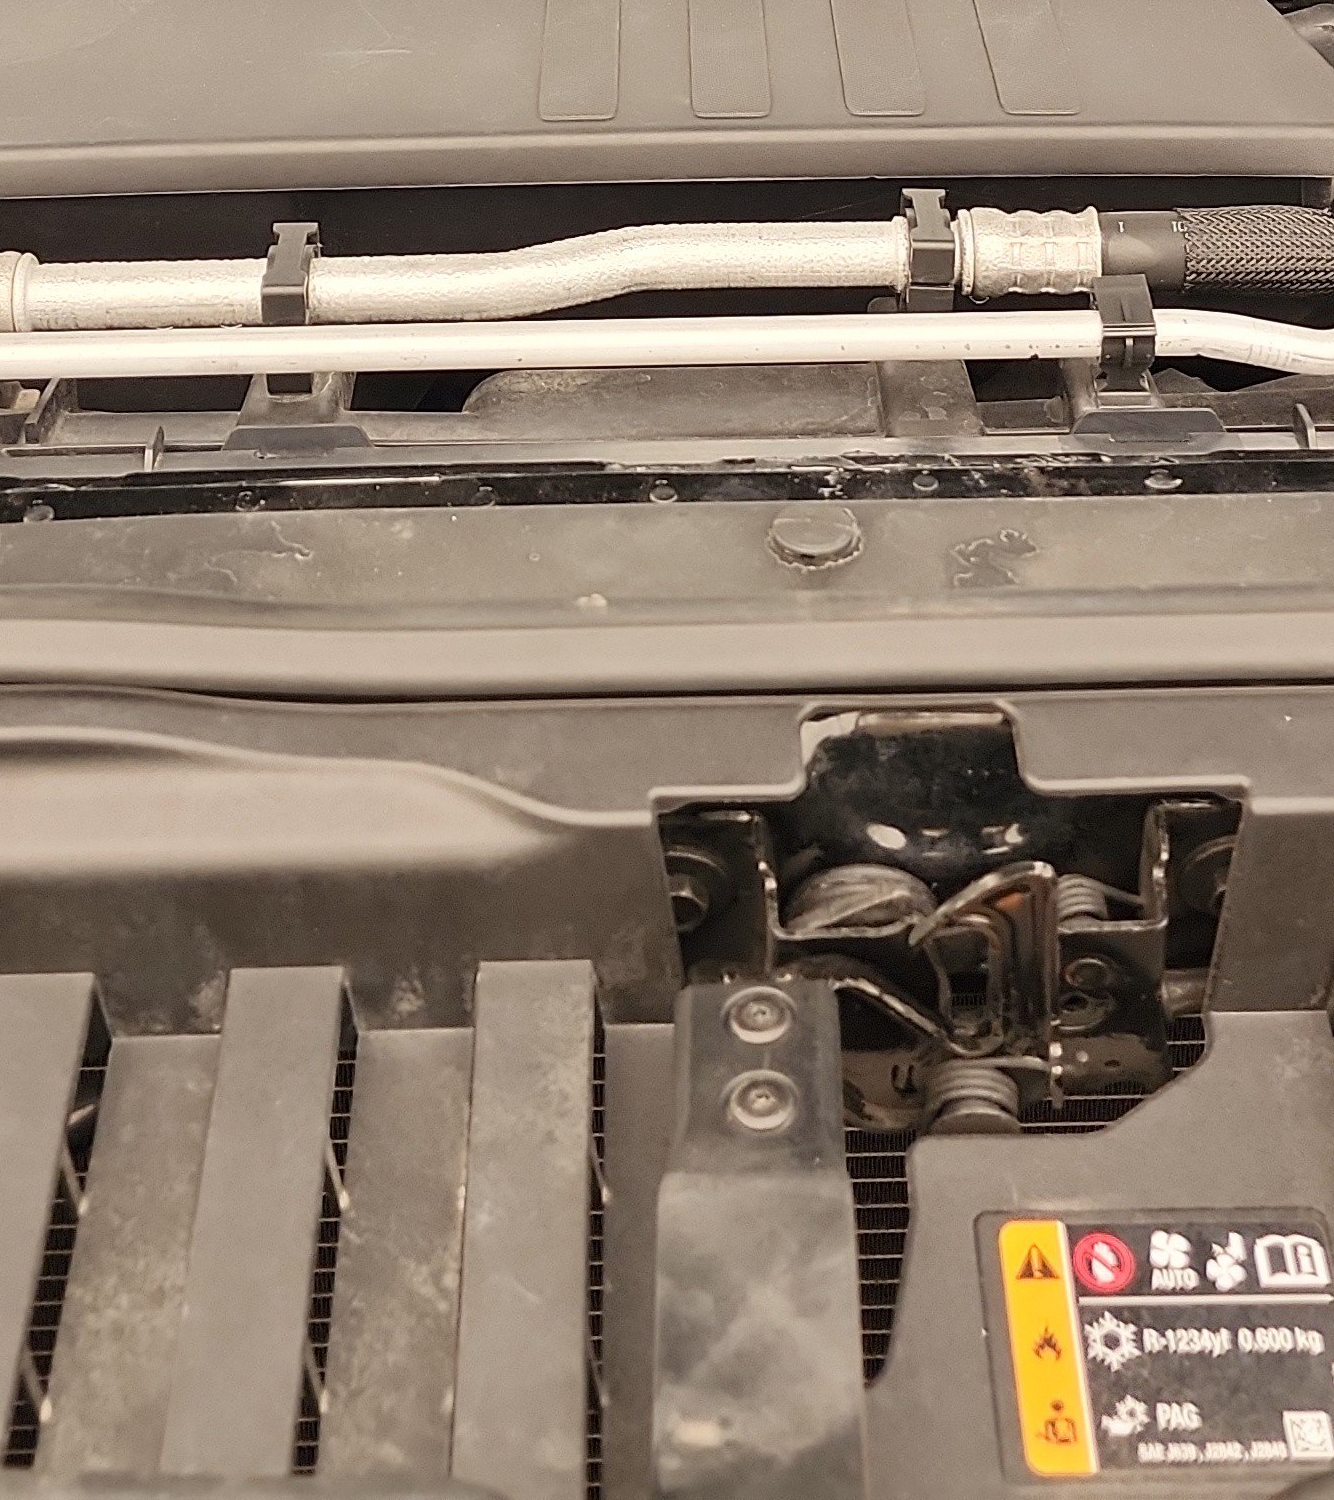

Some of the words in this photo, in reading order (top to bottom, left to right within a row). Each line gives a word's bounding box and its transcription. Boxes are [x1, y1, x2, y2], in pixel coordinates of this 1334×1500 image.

[1151, 1269, 1200, 1291] AUTO
[1237, 1327, 1295, 1353] 0.600
[1294, 1326, 1326, 1356] kg
[1155, 1401, 1203, 1432] PAG
